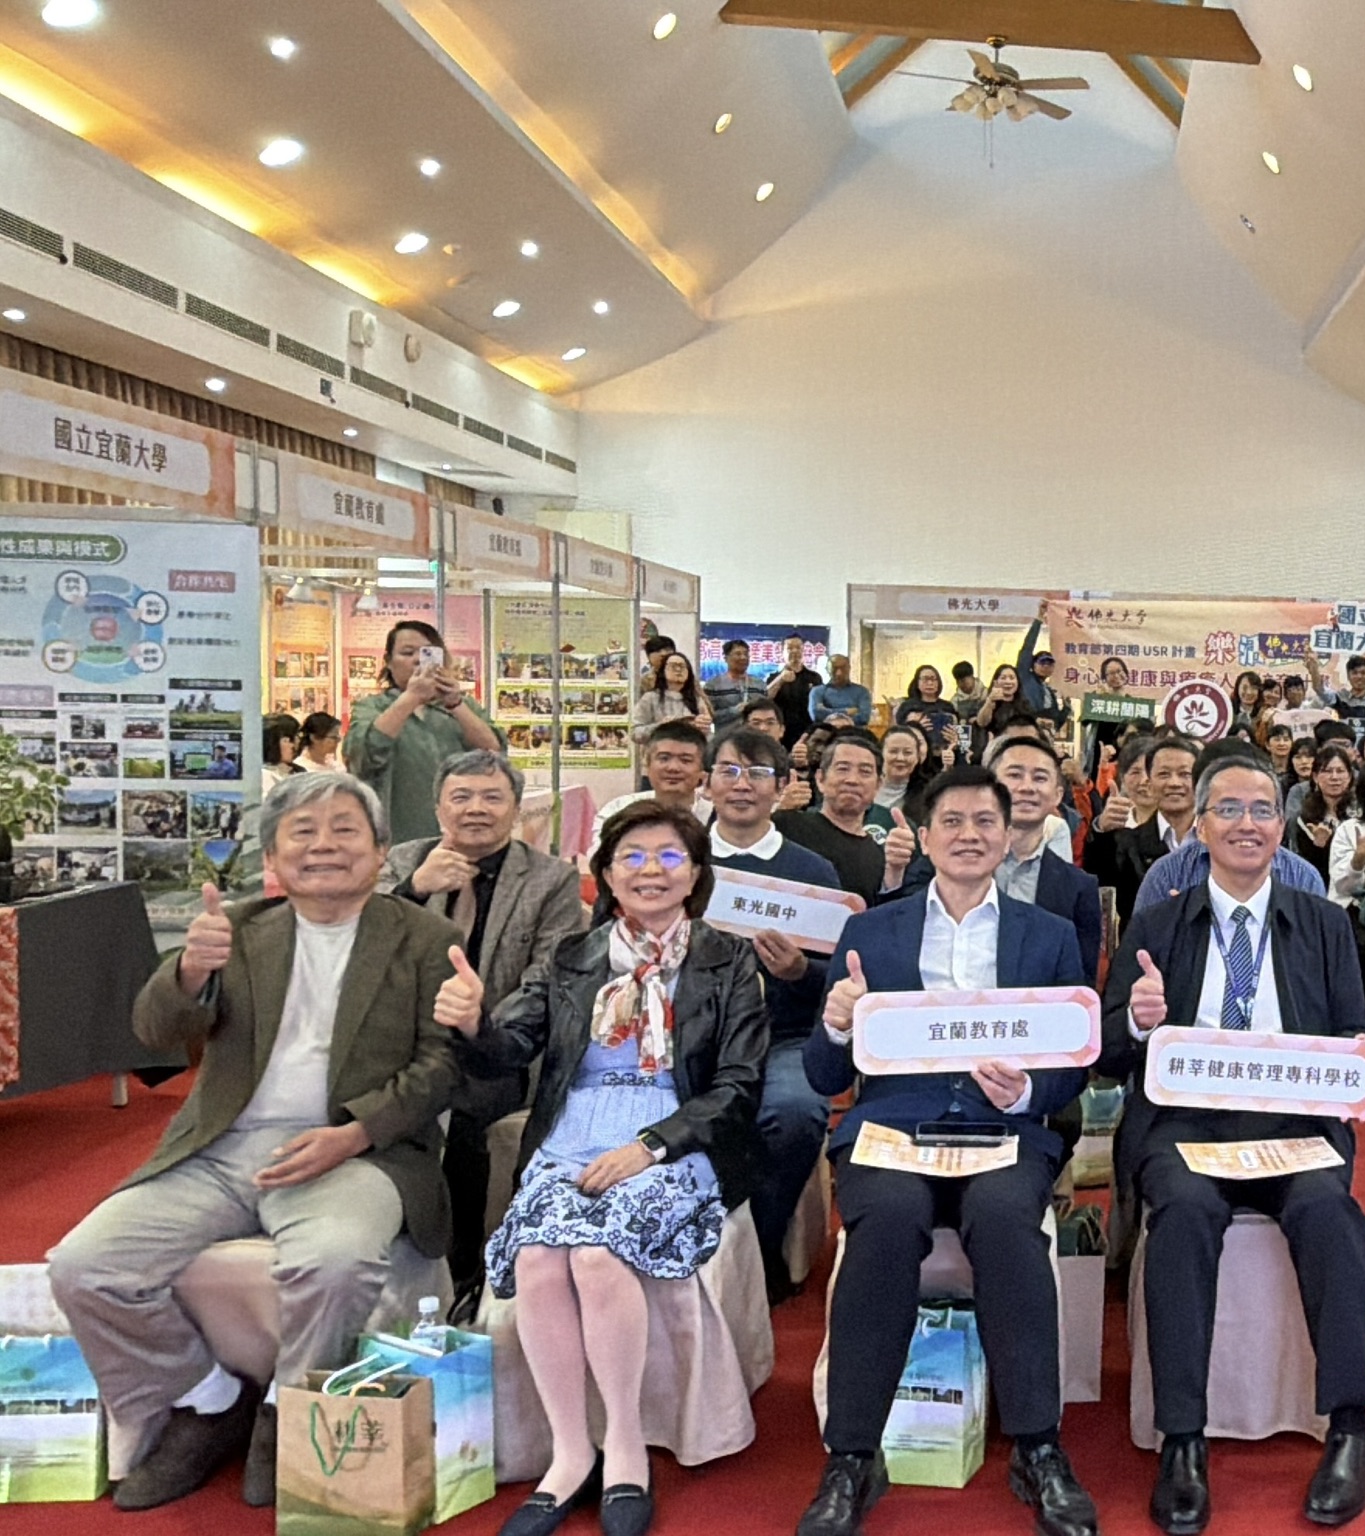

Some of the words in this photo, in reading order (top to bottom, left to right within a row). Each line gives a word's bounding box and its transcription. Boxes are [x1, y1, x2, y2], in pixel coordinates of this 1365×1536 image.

[54, 416, 168, 473] 國立宜蘭大學
[947, 598, 1000, 612] 佛光大學
[1064, 642, 1140, 657] 教育部第四期
[1143, 645, 1169, 657] USR
[1171, 646, 1197, 658] 計畫
[1090, 698, 1151, 718] 深耕蘭陽
[731, 896, 798, 921] 東光國中
[928, 1019, 1030, 1041] 宜蘭教育處
[1168, 1056, 1362, 1088] 耕莘健康管理專科學校
